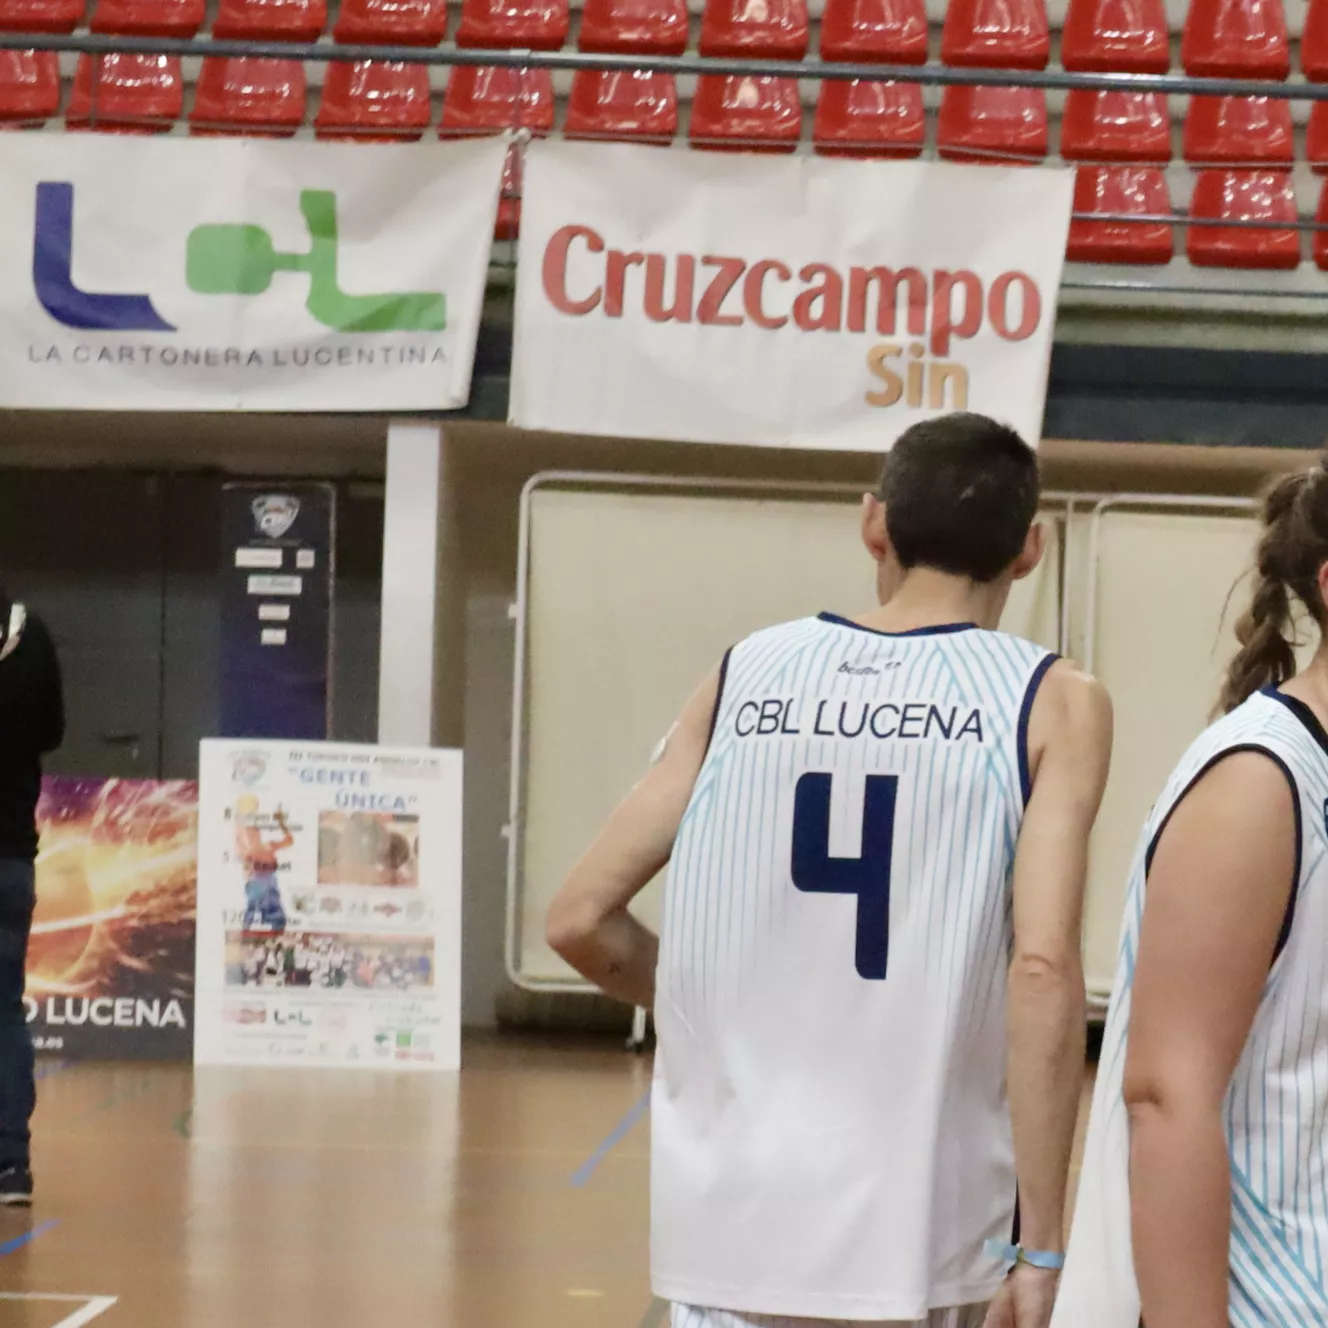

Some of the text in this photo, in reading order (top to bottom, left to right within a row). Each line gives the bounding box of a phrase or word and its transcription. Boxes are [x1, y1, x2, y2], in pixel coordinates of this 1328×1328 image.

[541, 224, 1043, 357] Cruzcampo
[28, 345, 447, 367] LA CARTONERA LUCENTINA
[864, 343, 970, 410] Sin
[734, 697, 985, 743] CBL LUCENA
[791, 771, 899, 980] 4
[46, 997, 187, 1028] LUCENA
